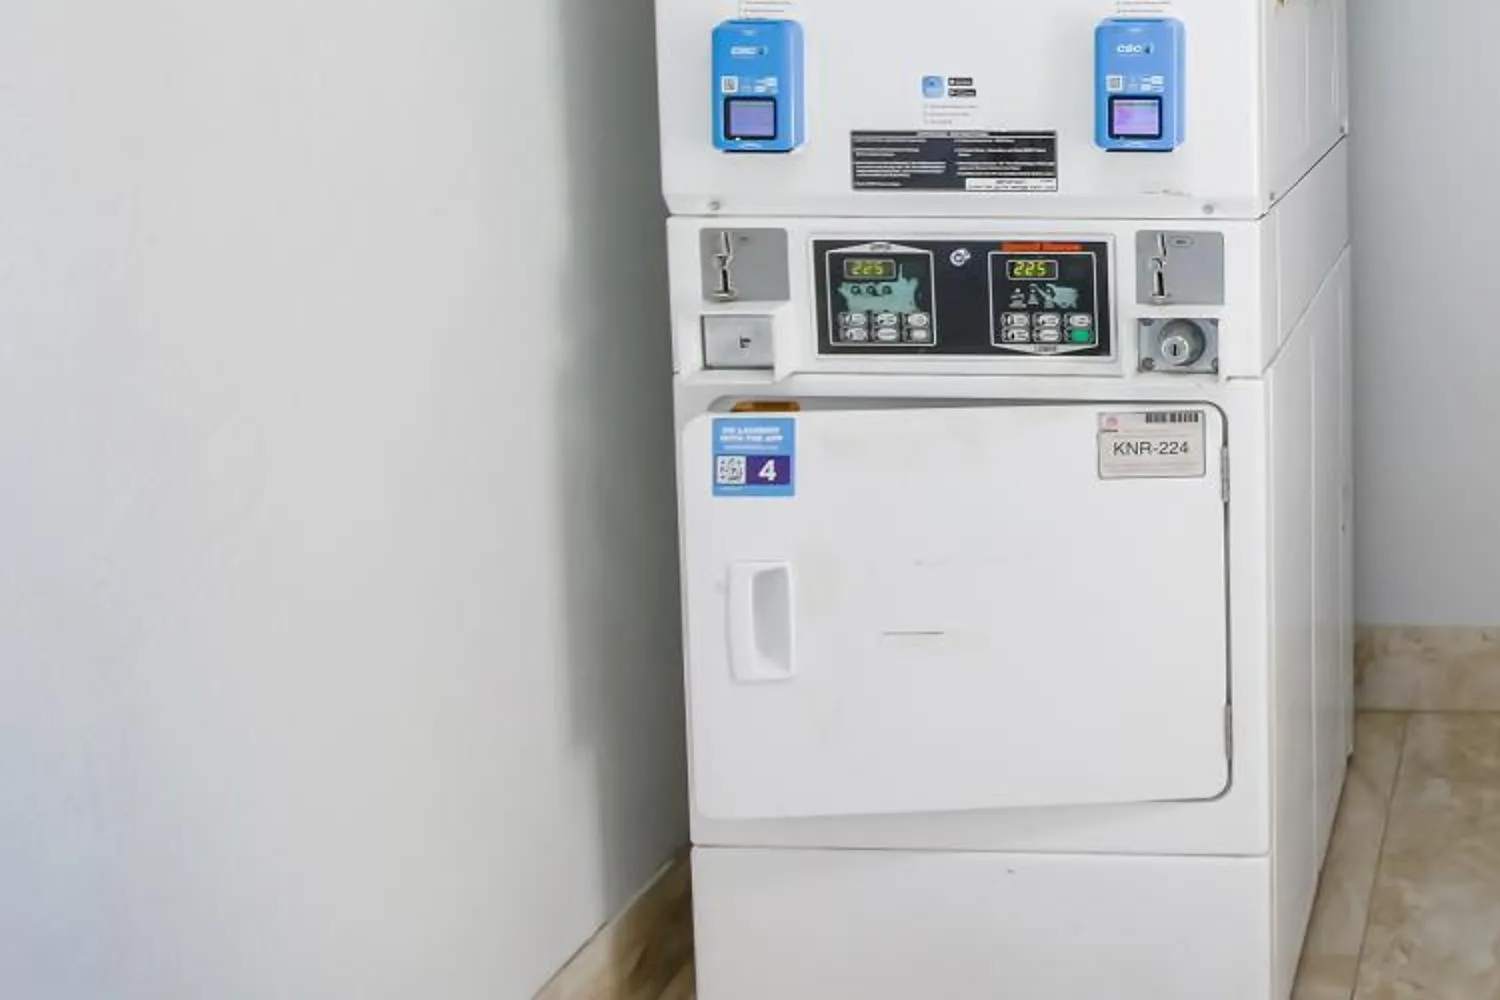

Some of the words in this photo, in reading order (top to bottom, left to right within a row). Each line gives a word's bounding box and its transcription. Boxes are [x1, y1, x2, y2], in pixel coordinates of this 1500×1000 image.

[851, 262, 883, 275] 225
[1014, 261, 1046, 276] 225
[1113, 441, 1189, 456] KNR-224
[758, 459, 777, 481] 4
